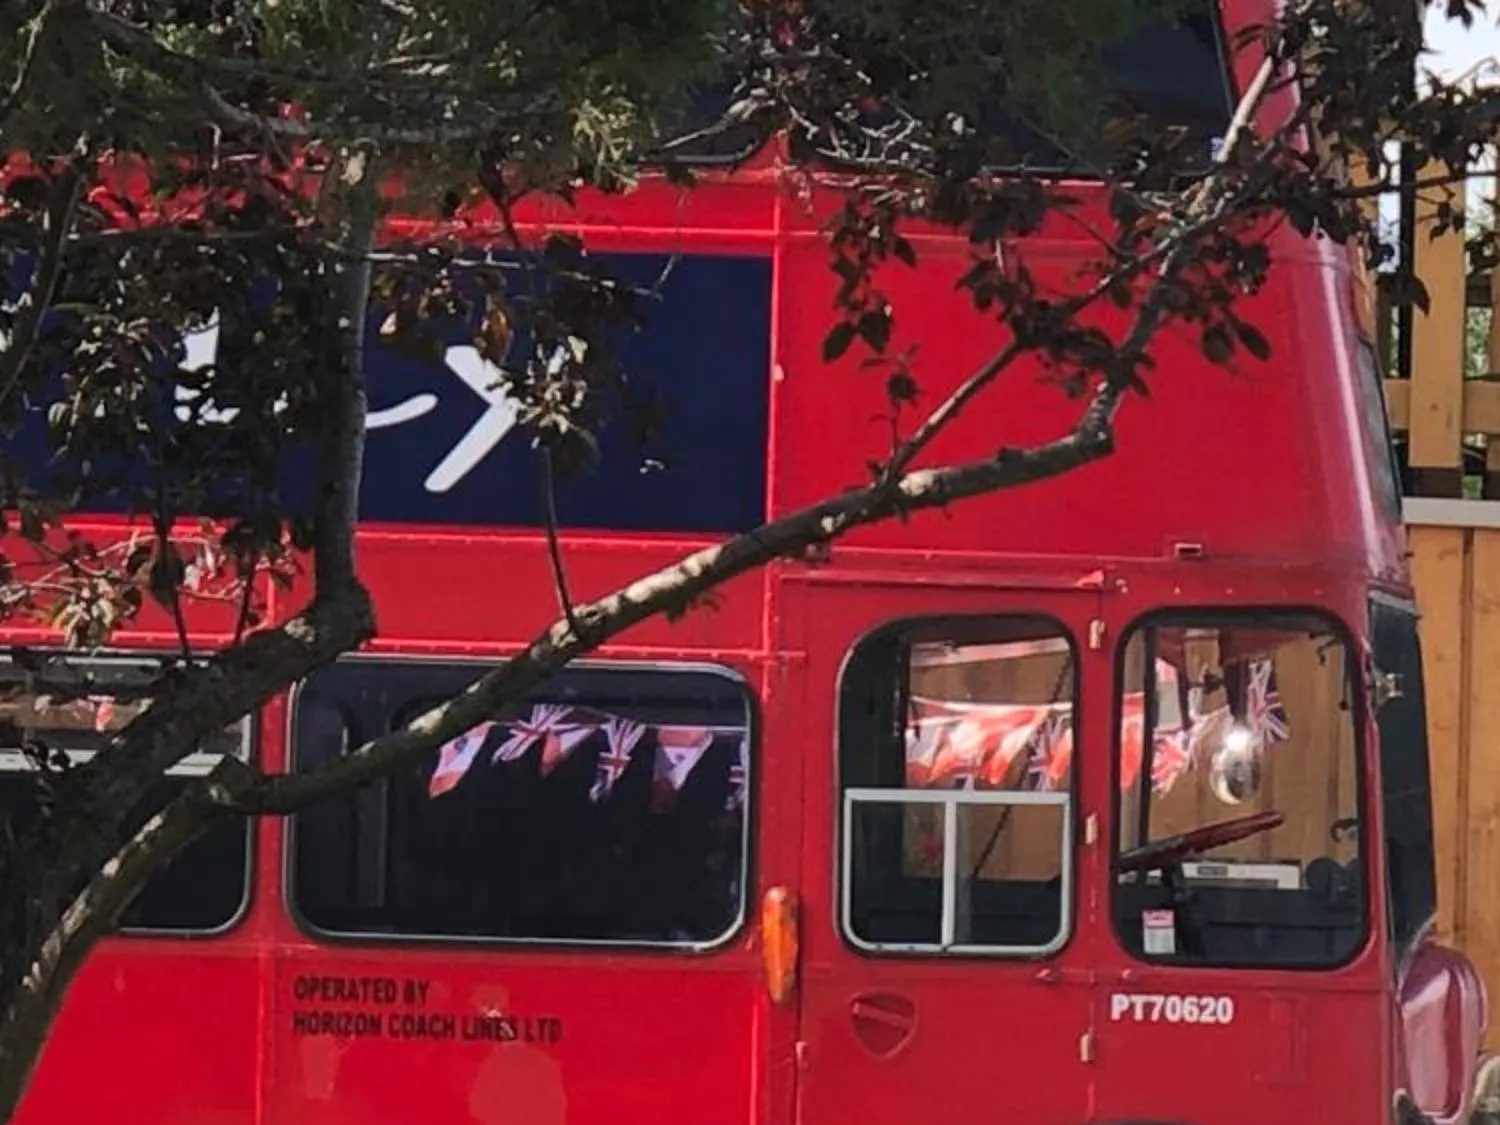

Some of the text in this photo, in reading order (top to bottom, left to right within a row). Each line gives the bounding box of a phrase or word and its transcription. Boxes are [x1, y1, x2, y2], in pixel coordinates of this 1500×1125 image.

[293, 976, 430, 1005] OPERATED BY
[1110, 993, 1234, 1023] PT70620
[293, 1010, 563, 1042] HORIZON COACH LINES LTD
